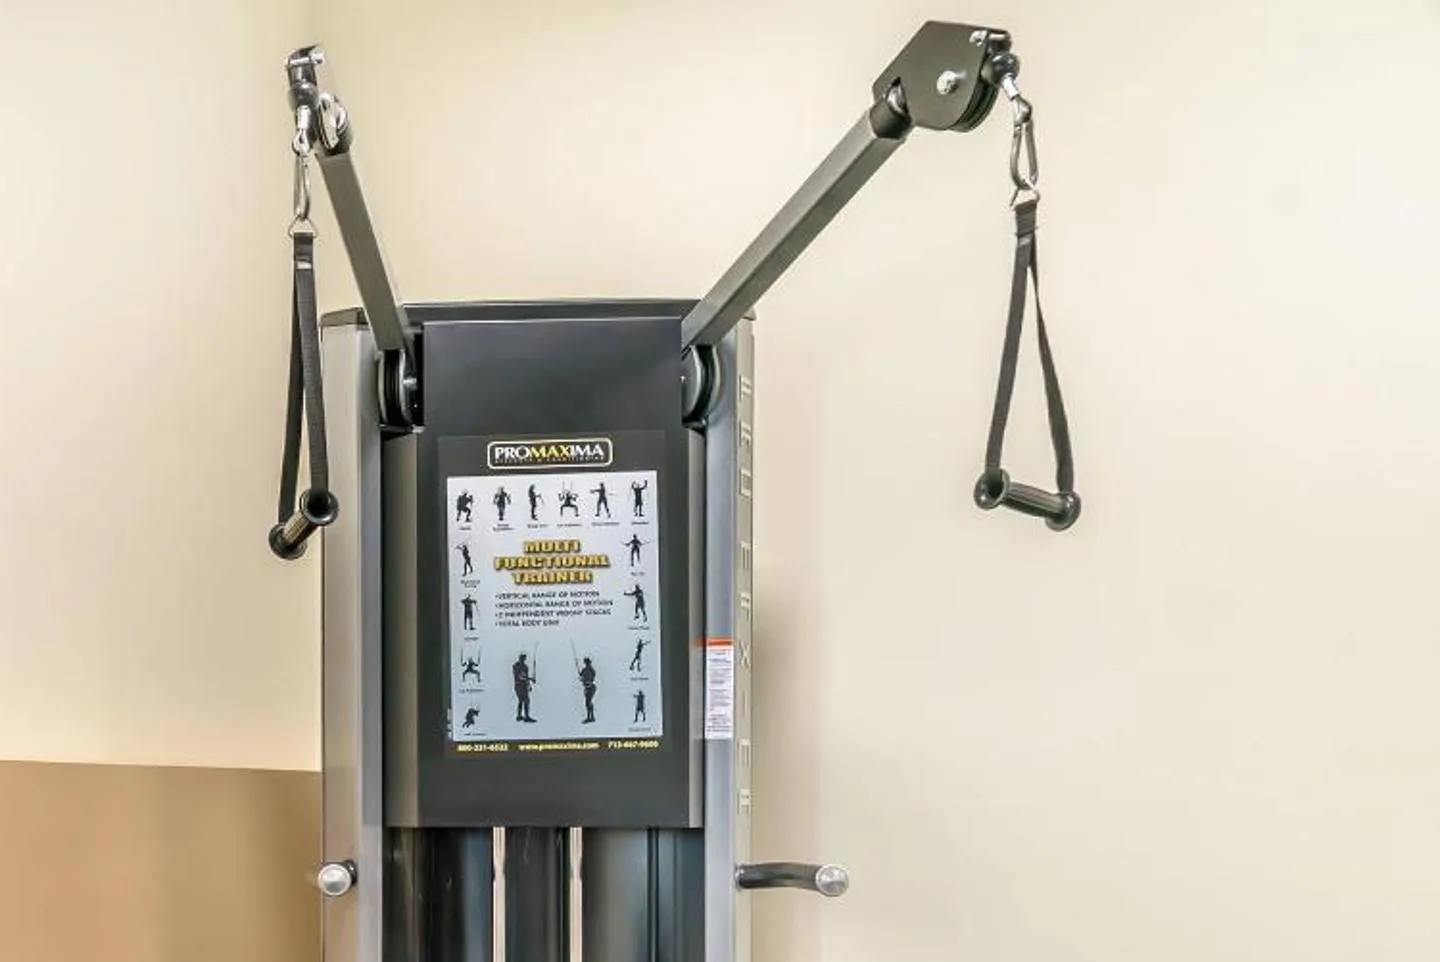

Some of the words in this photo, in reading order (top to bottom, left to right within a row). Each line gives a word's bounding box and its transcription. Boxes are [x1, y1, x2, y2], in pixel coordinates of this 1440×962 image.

[494, 443, 605, 459] PROMAXIMA
[524, 540, 581, 554] MULTI
[494, 554, 611, 571] FUNCTIONAL
[513, 571, 594, 584] TRAINER
